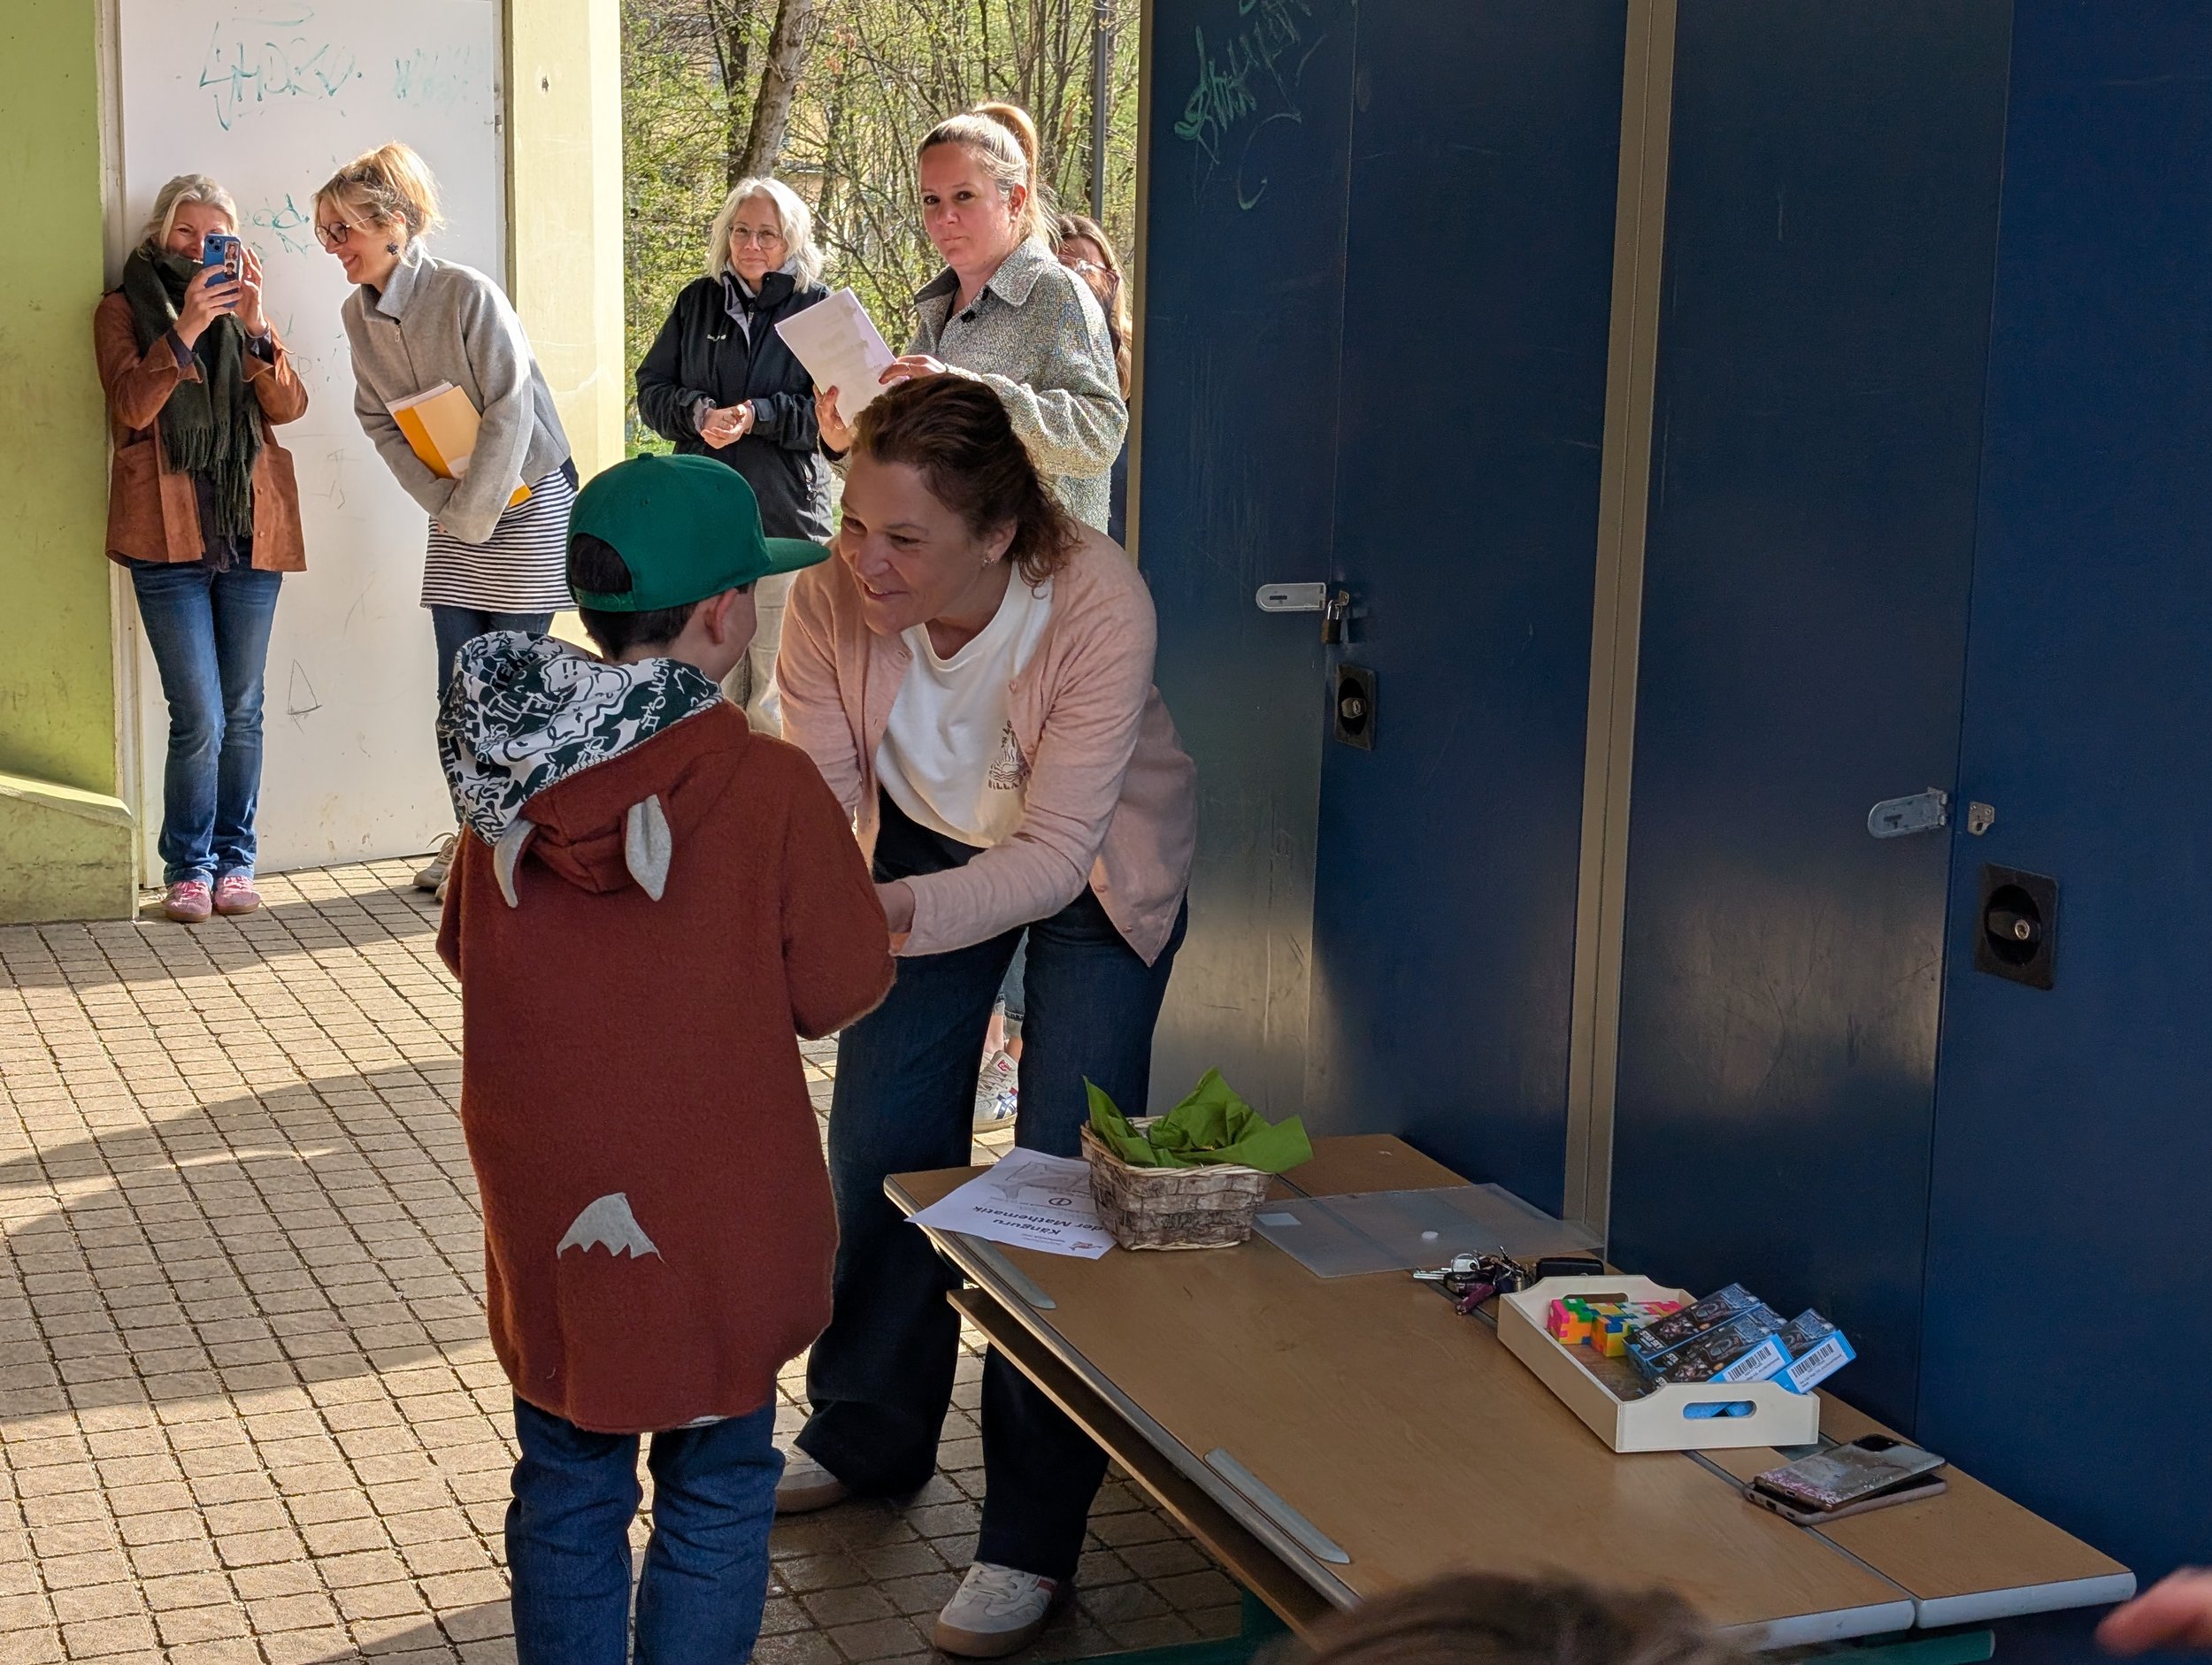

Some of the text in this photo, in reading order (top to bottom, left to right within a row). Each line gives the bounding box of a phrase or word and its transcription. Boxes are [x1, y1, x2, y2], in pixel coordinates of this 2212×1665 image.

[973, 1206, 1072, 1227] Mathematik
[993, 1218, 1062, 1235] Känguru
[1074, 1223, 1104, 1232] der
